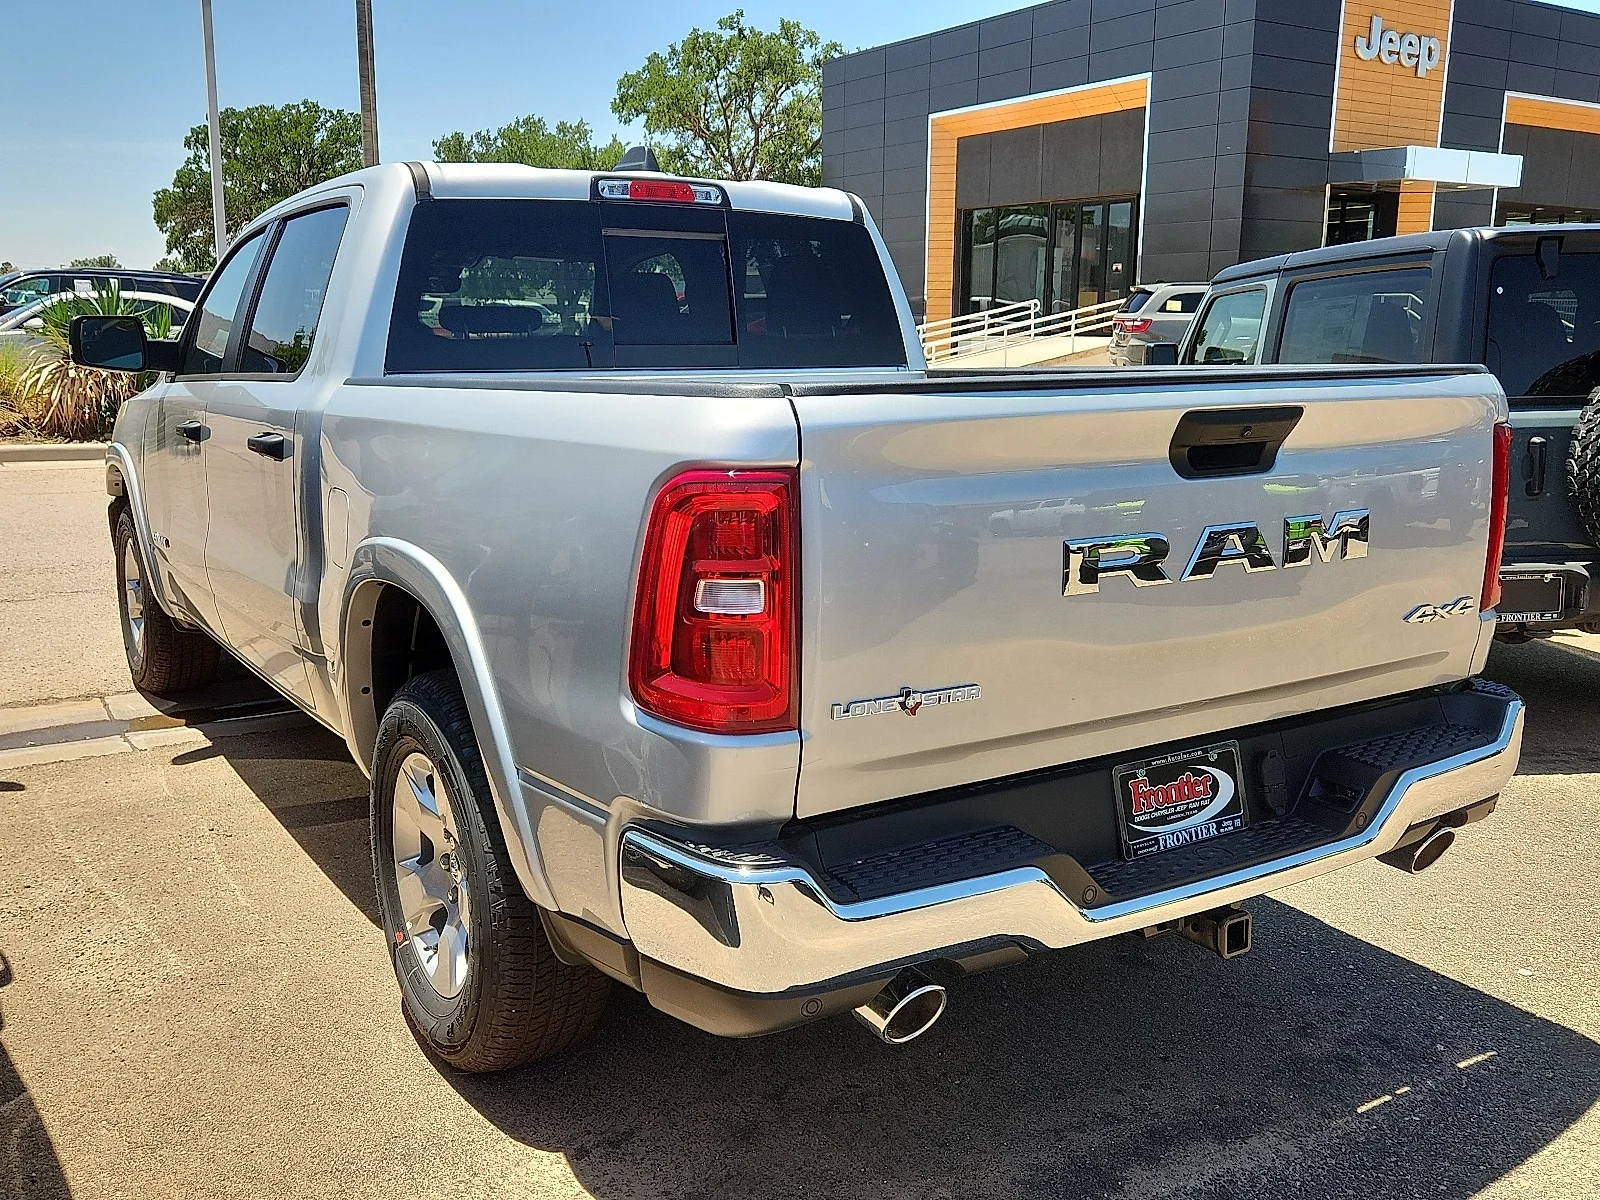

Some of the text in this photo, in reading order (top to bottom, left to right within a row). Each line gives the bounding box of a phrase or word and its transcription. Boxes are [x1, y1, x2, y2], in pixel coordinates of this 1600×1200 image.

[1355, 15, 1440, 77] Jeep
[1062, 508, 1370, 597] RAM
[1501, 613, 1541, 622] FRONTIER
[831, 684, 981, 720] LONE STAR
[1129, 772, 1212, 815] Frontier
[1134, 813, 1151, 822] DODGE
[1150, 806, 1175, 818] CHRYSLER
[1175, 803, 1188, 813] JEEP
[1158, 822, 1218, 850] FRONTIER
